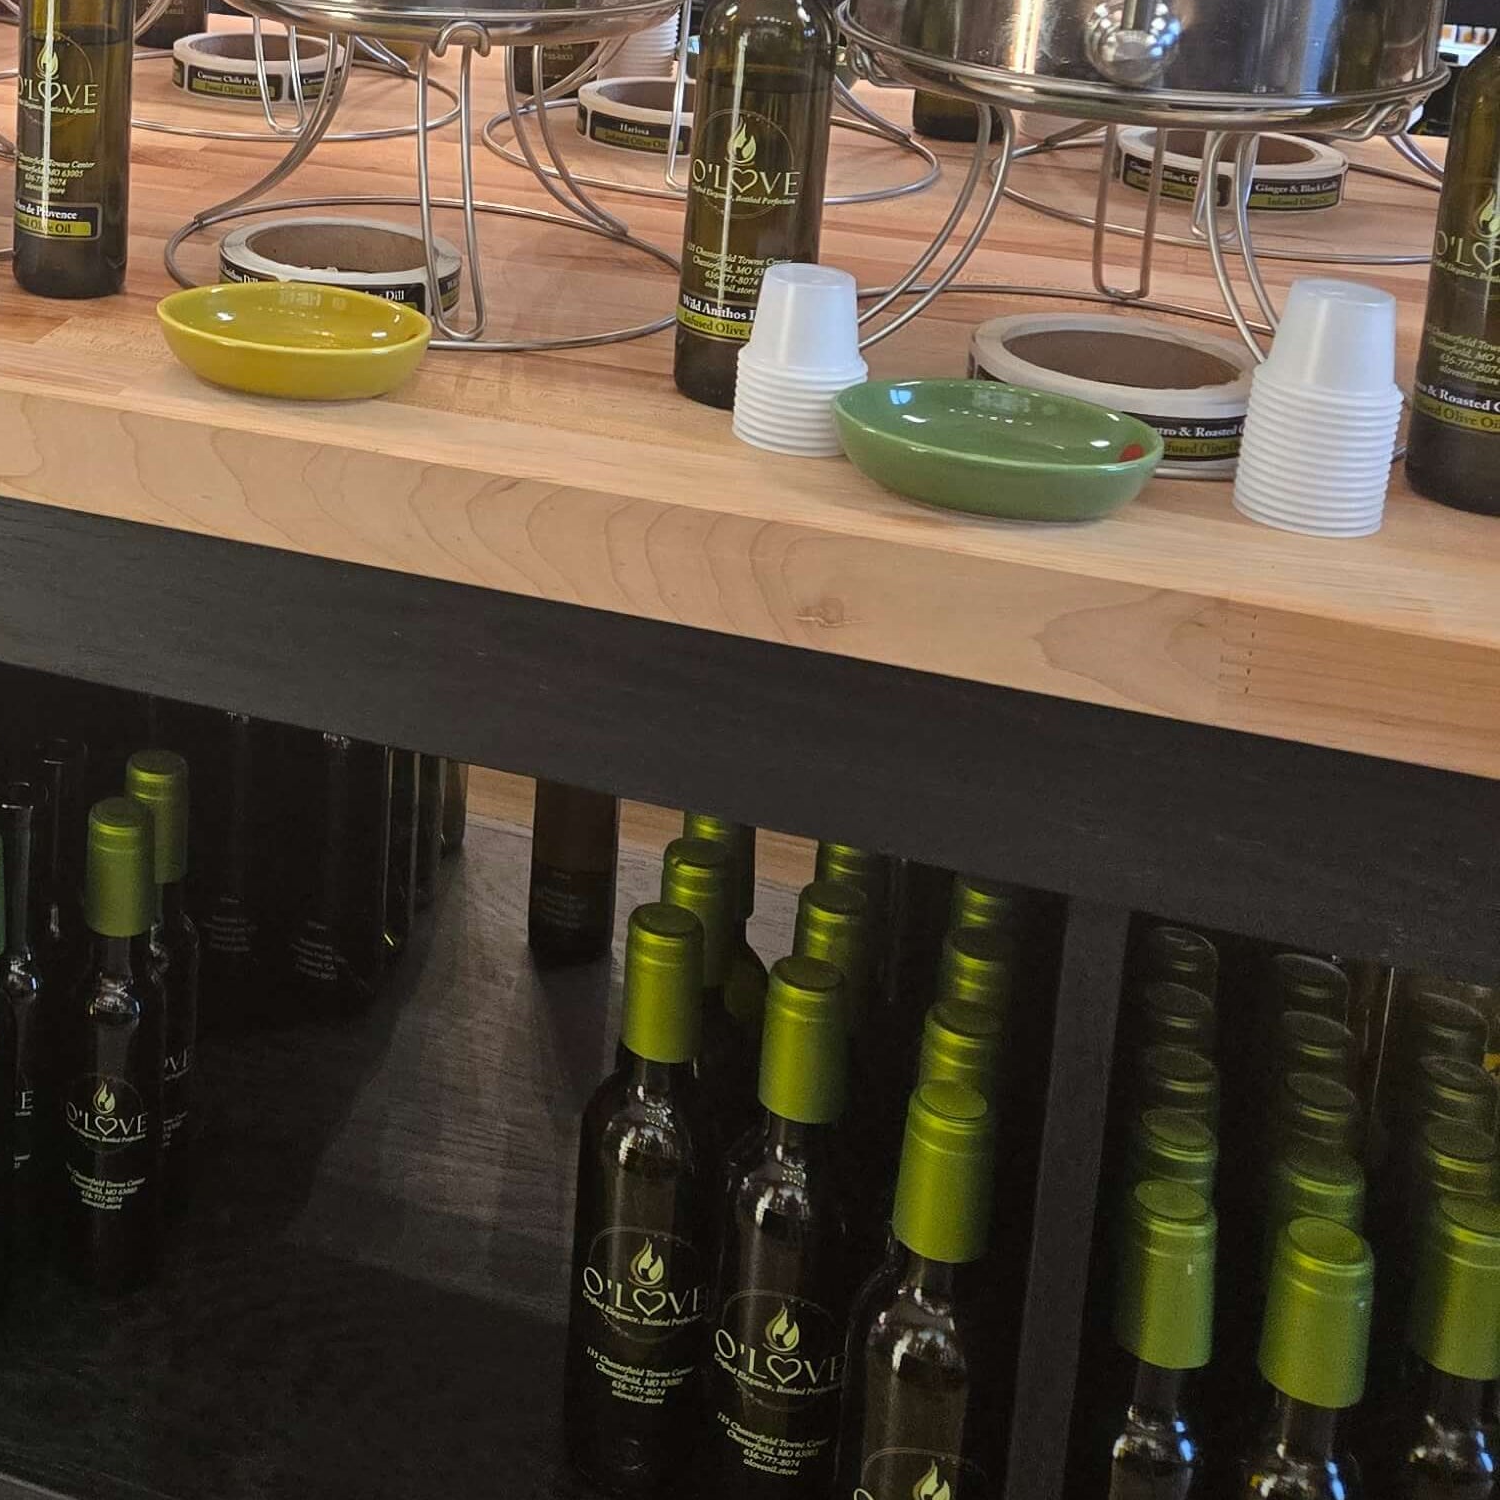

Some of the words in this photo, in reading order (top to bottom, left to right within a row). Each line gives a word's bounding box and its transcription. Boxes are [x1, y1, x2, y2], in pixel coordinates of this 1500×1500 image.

[36, 206, 77, 220] Provence
[55, 223, 71, 233] Oil
[704, 270, 759, 286] 636-77-8074
[736, 267, 753, 276] MO
[386, 290, 405, 301] Dill
[682, 293, 701, 311] Wild
[715, 322, 745, 336] Olive
[1477, 336, 1500, 353] Tow
[1475, 350, 1495, 363] MO
[1427, 384, 1437, 397] &
[1438, 386, 1490, 411] Roasted
[1443, 407, 1477, 426] Olive
[1179, 427, 1192, 437] &
[584, 1266, 698, 1316] O'LOV
[777, 1448, 793, 1457] MO
